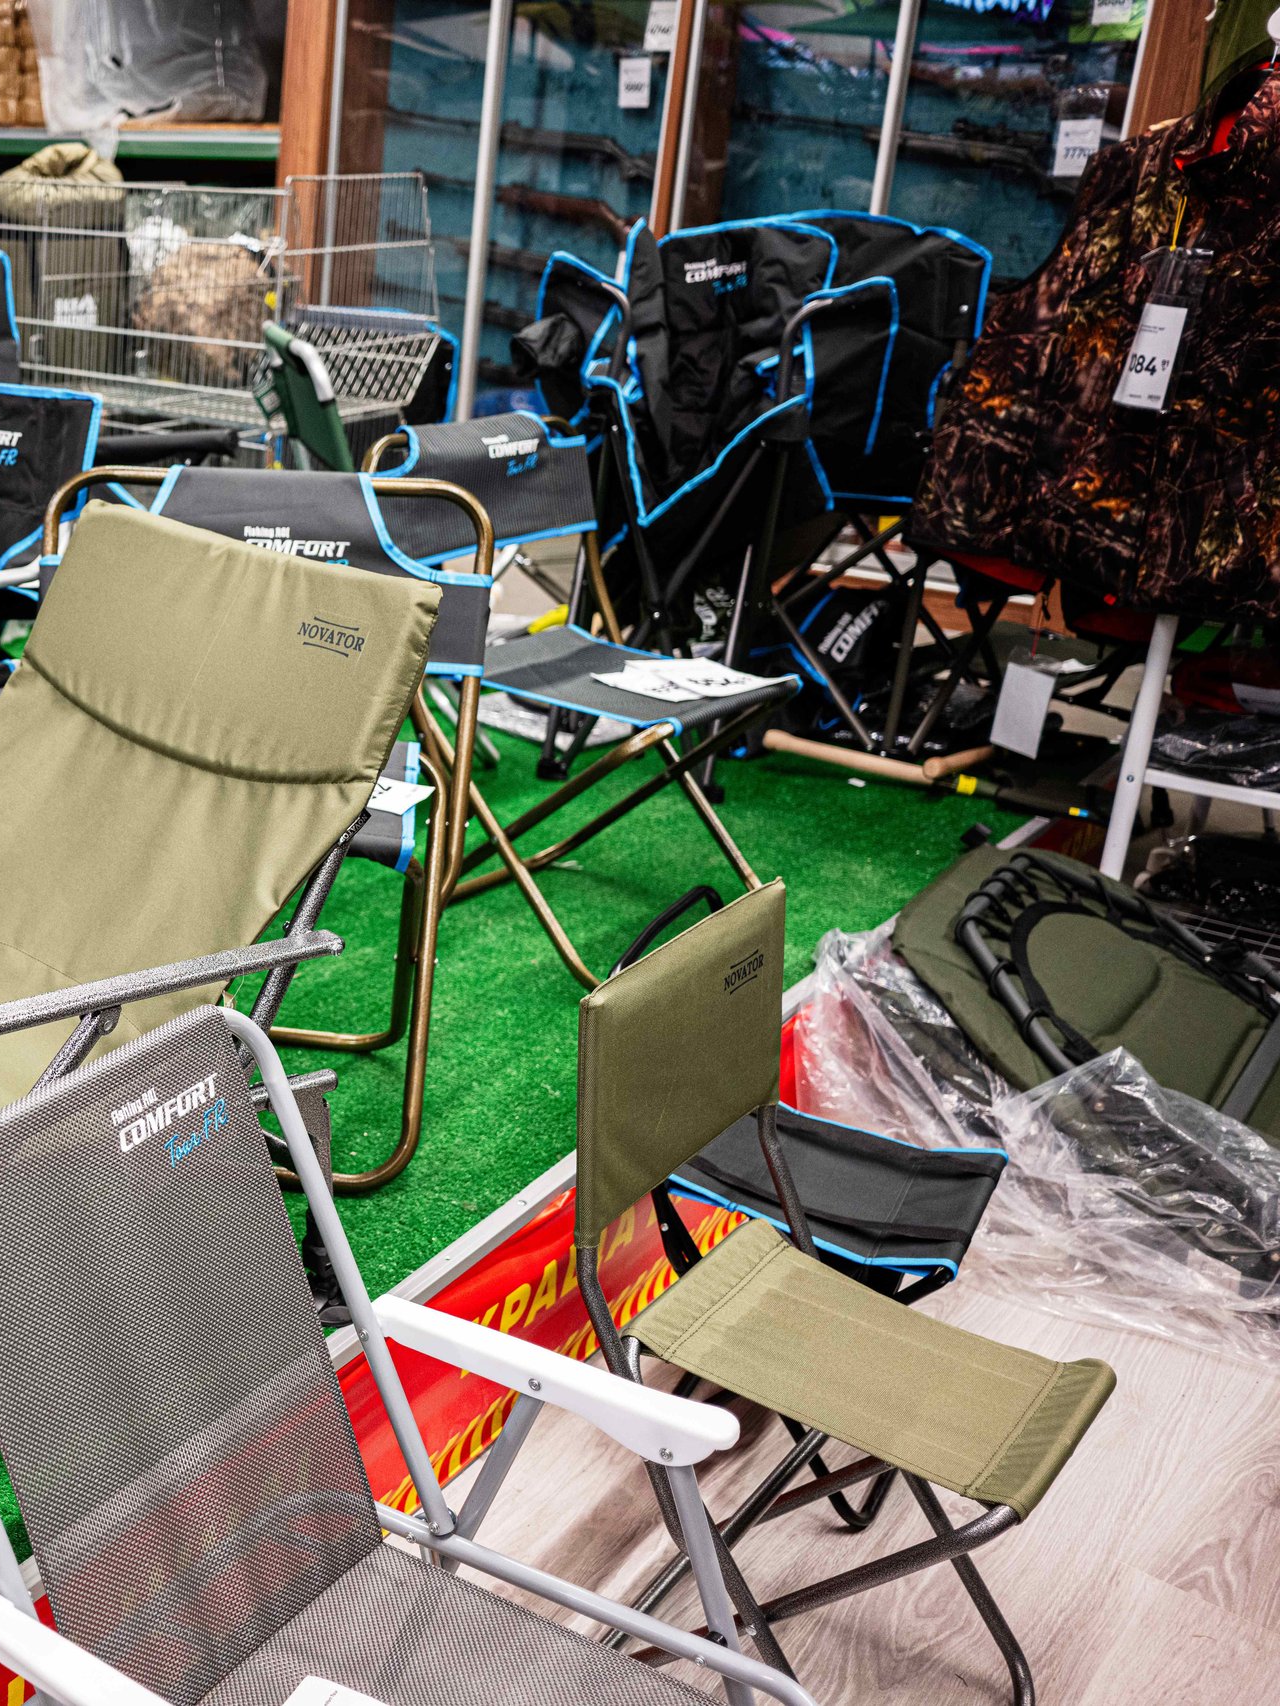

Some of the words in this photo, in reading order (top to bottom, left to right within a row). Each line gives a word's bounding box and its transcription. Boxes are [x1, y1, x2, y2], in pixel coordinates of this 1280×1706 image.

[297, 621, 365, 652] NOVATOR
[724, 953, 764, 991] NOVATOR
[119, 1072, 219, 1154] COMFORT
[163, 1133, 201, 1168] Tour
[202, 1098, 229, 1139] FR
